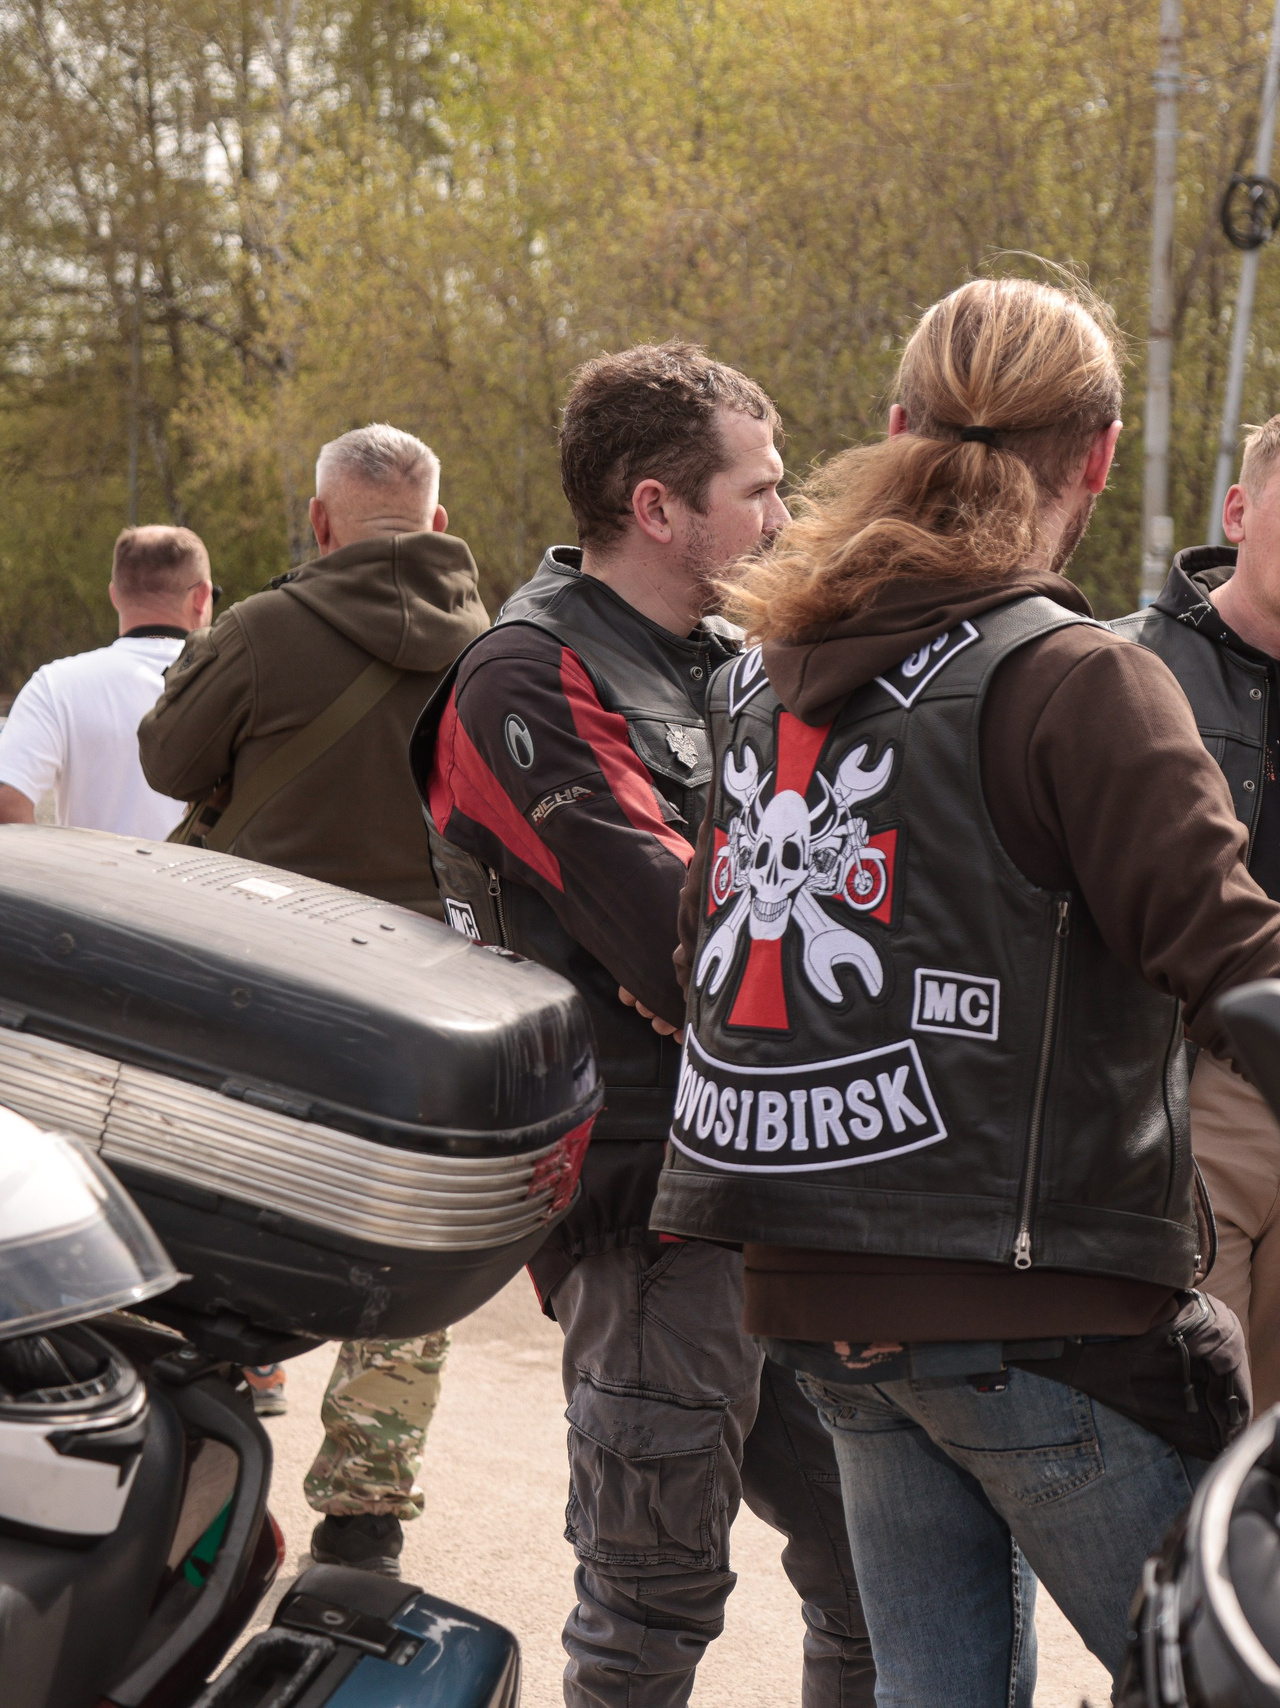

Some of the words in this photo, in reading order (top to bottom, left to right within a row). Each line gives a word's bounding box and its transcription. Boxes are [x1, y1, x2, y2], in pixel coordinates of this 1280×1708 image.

[531, 786, 592, 822] RICHA
[922, 980, 990, 1027] MC
[674, 1049, 928, 1152] OVOSIBIRSK
